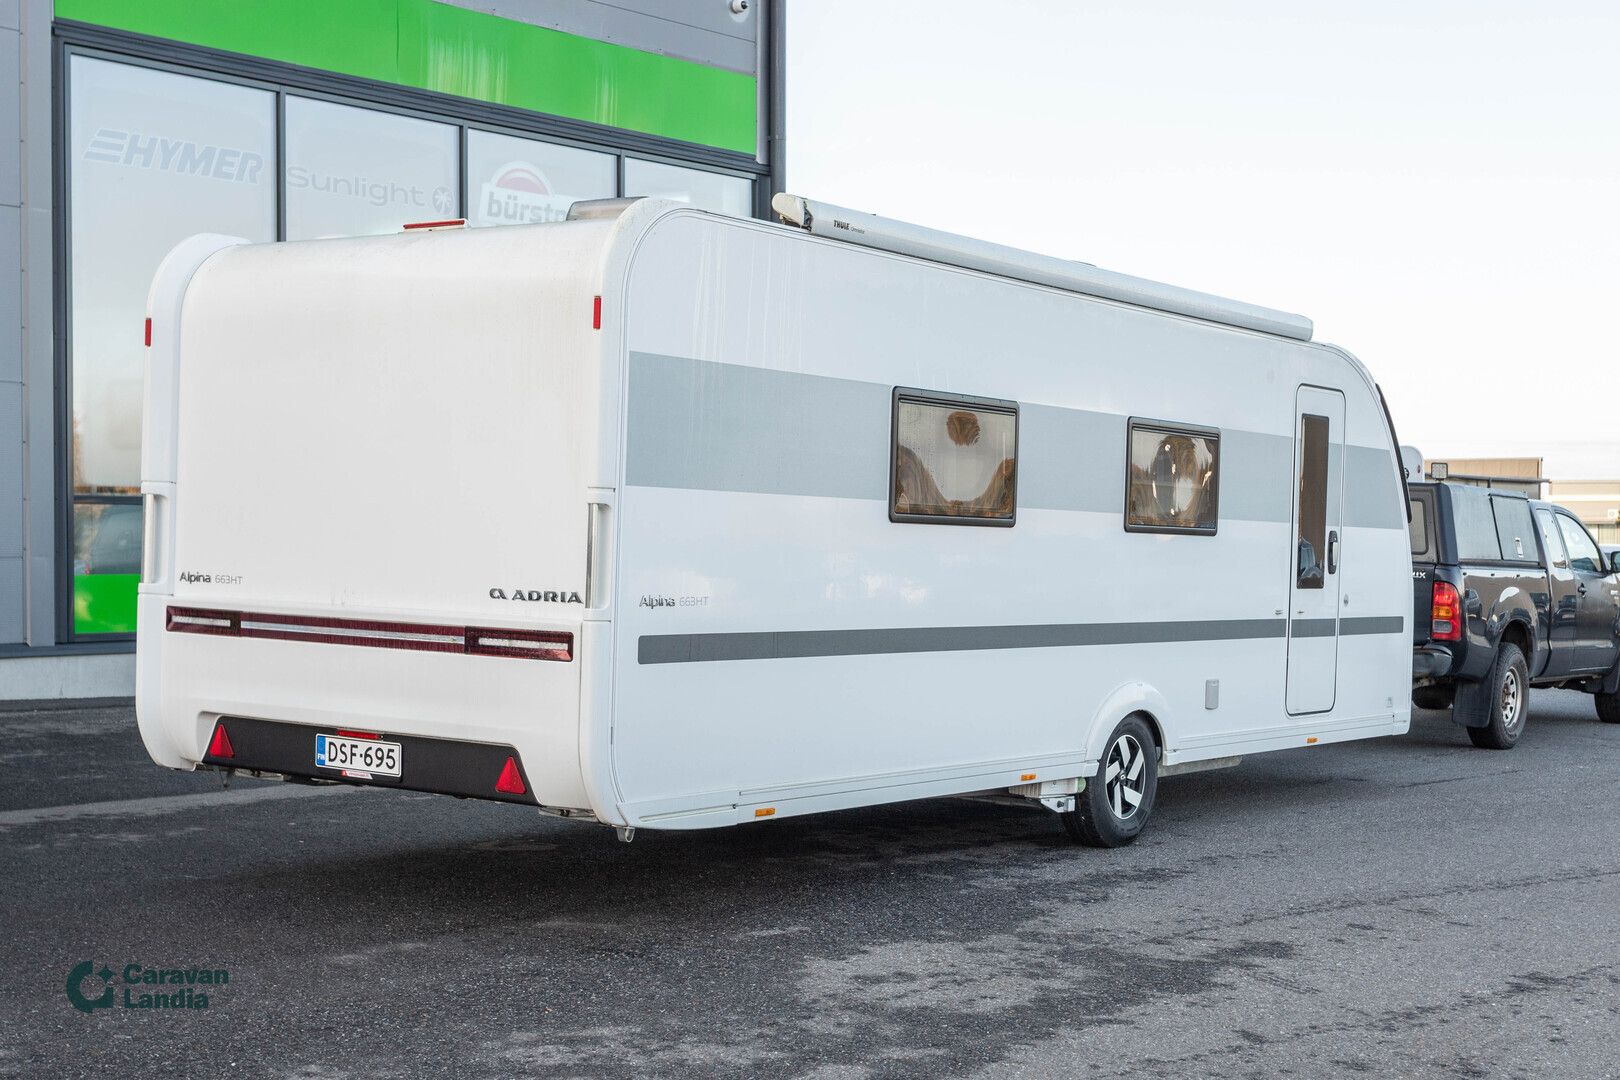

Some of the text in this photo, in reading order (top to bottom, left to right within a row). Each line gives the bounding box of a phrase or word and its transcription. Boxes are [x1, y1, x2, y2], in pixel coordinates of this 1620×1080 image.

[121, 133, 264, 185] HYMER
[286, 166, 425, 207] Sunlight
[179, 571, 243, 584] Alpina 663HT
[511, 589, 584, 604] ADRIA
[639, 594, 709, 609] Alpina 663HT
[328, 741, 396, 770] DSF-695
